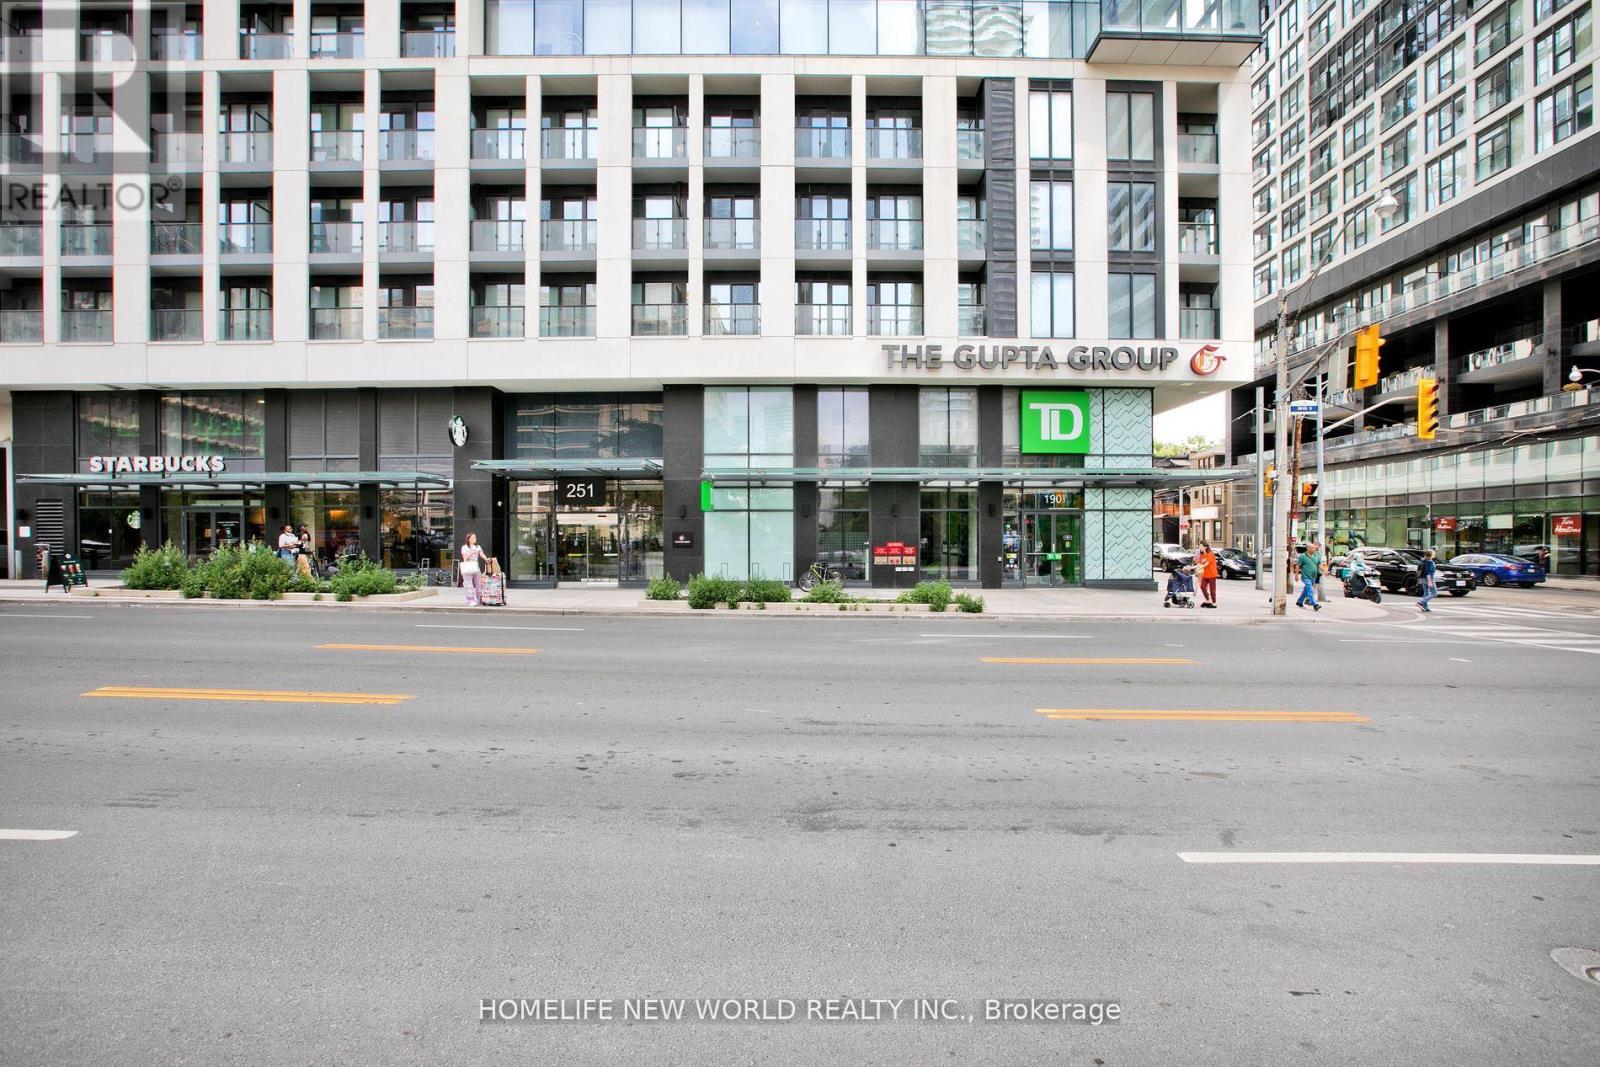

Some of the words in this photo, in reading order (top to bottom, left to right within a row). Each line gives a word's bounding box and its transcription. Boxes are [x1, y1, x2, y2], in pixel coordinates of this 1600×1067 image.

[881, 344, 943, 369] THE
[953, 344, 1059, 370] GUPTA
[1067, 345, 1179, 371] GROUP
[1029, 403, 1084, 441] TD
[89, 456, 226, 473] STARBUCKS
[566, 483, 594, 498] 251
